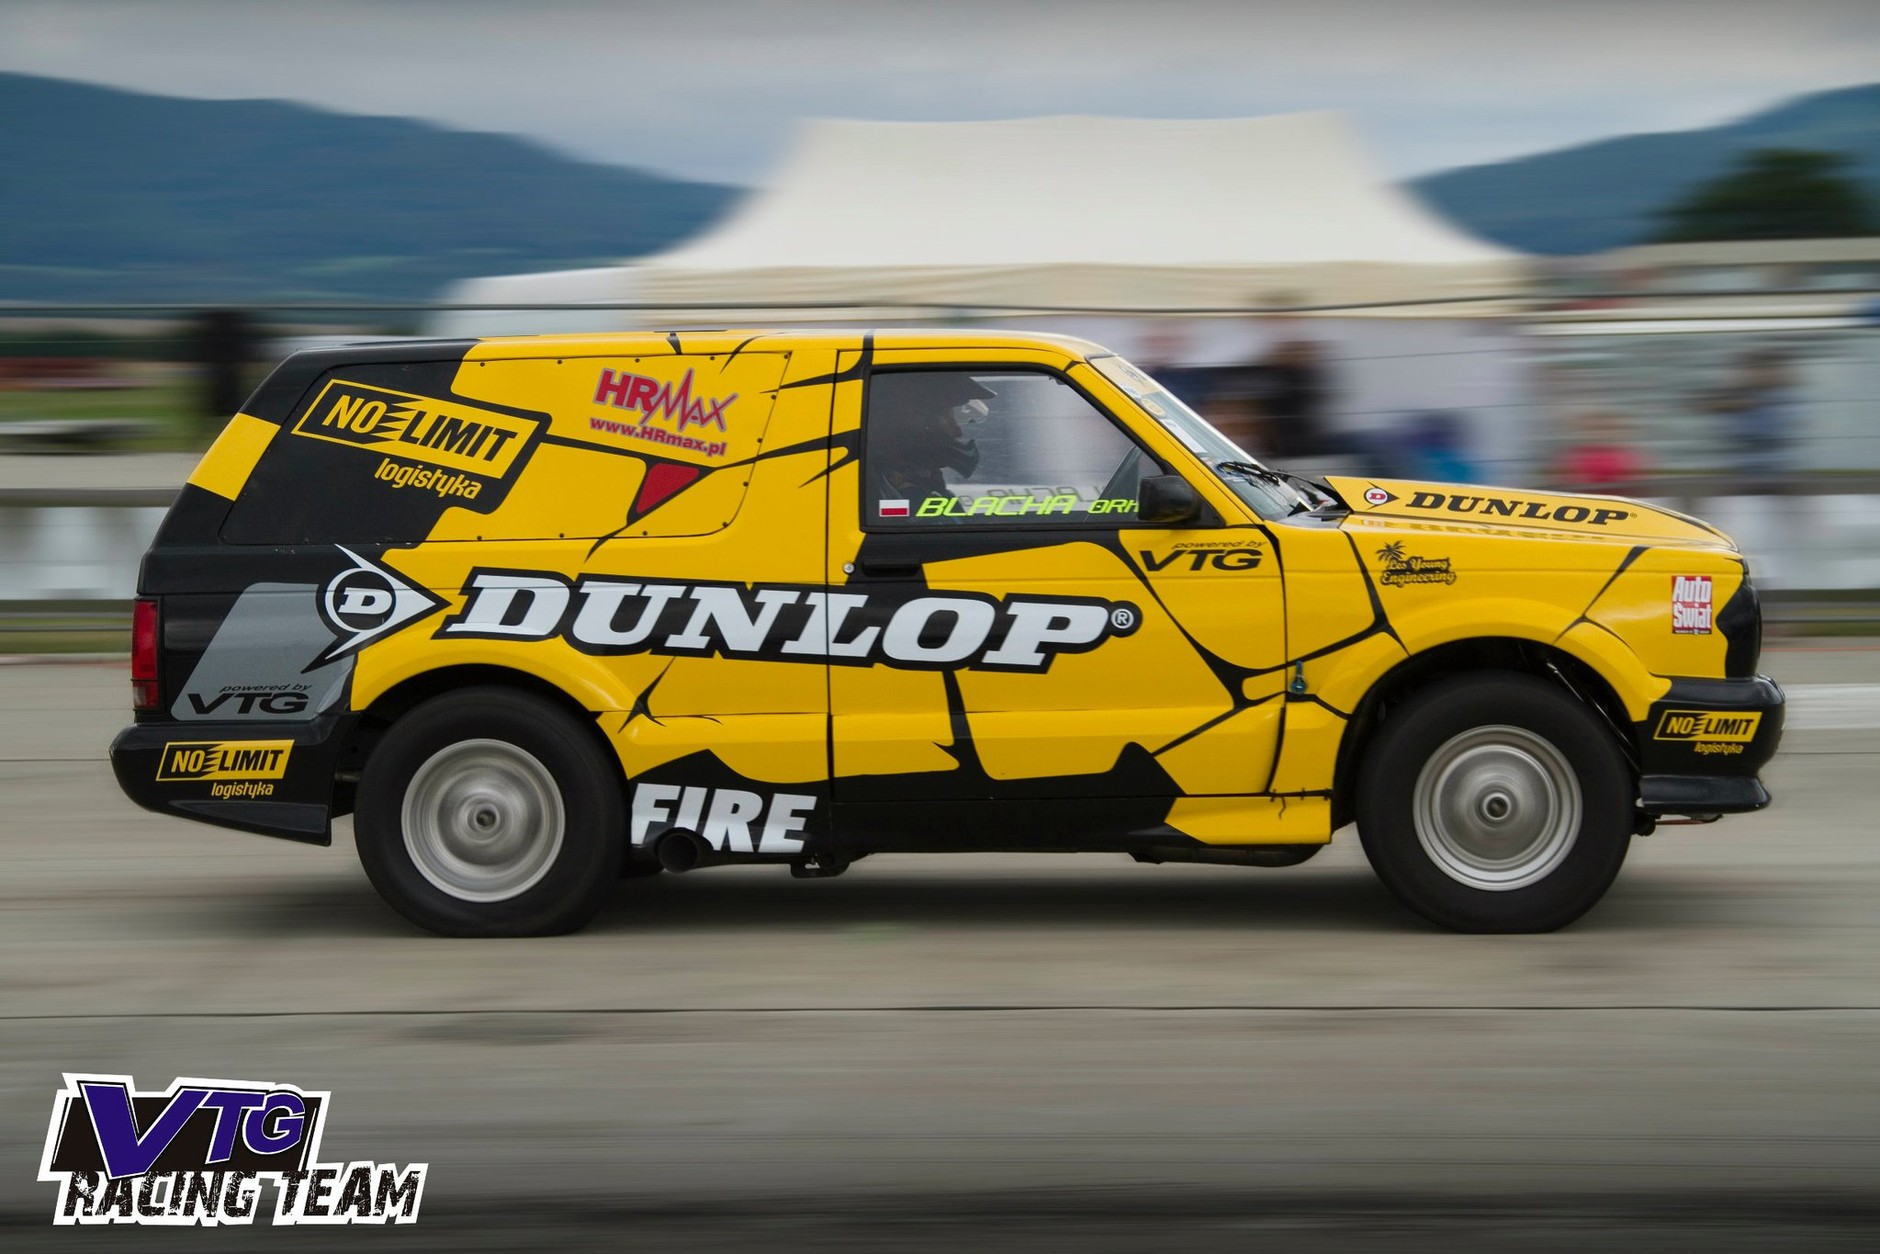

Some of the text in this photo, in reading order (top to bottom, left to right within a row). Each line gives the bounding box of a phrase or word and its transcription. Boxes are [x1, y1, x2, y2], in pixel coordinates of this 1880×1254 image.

[594, 368, 739, 432] HRMAX
[321, 394, 518, 462] NO LIMIT
[589, 416, 727, 457] www.HRmax.pl
[374, 457, 482, 500] logistyka
[915, 495, 1078, 517] BLACHA
[1172, 540, 1267, 550] powered by
[1139, 548, 1263, 572] VTG
[1381, 570, 1456, 587] Engineering
[1672, 576, 1712, 602] Auto
[219, 683, 312, 693] powered by
[188, 692, 309, 714] VTG
[1666, 717, 1754, 735] NO LIMIT
[1694, 742, 1744, 755] logistyka
[171, 750, 284, 773] NO LIMIT
[211, 781, 274, 799] logistyka
[631, 782, 817, 853] FIRE
